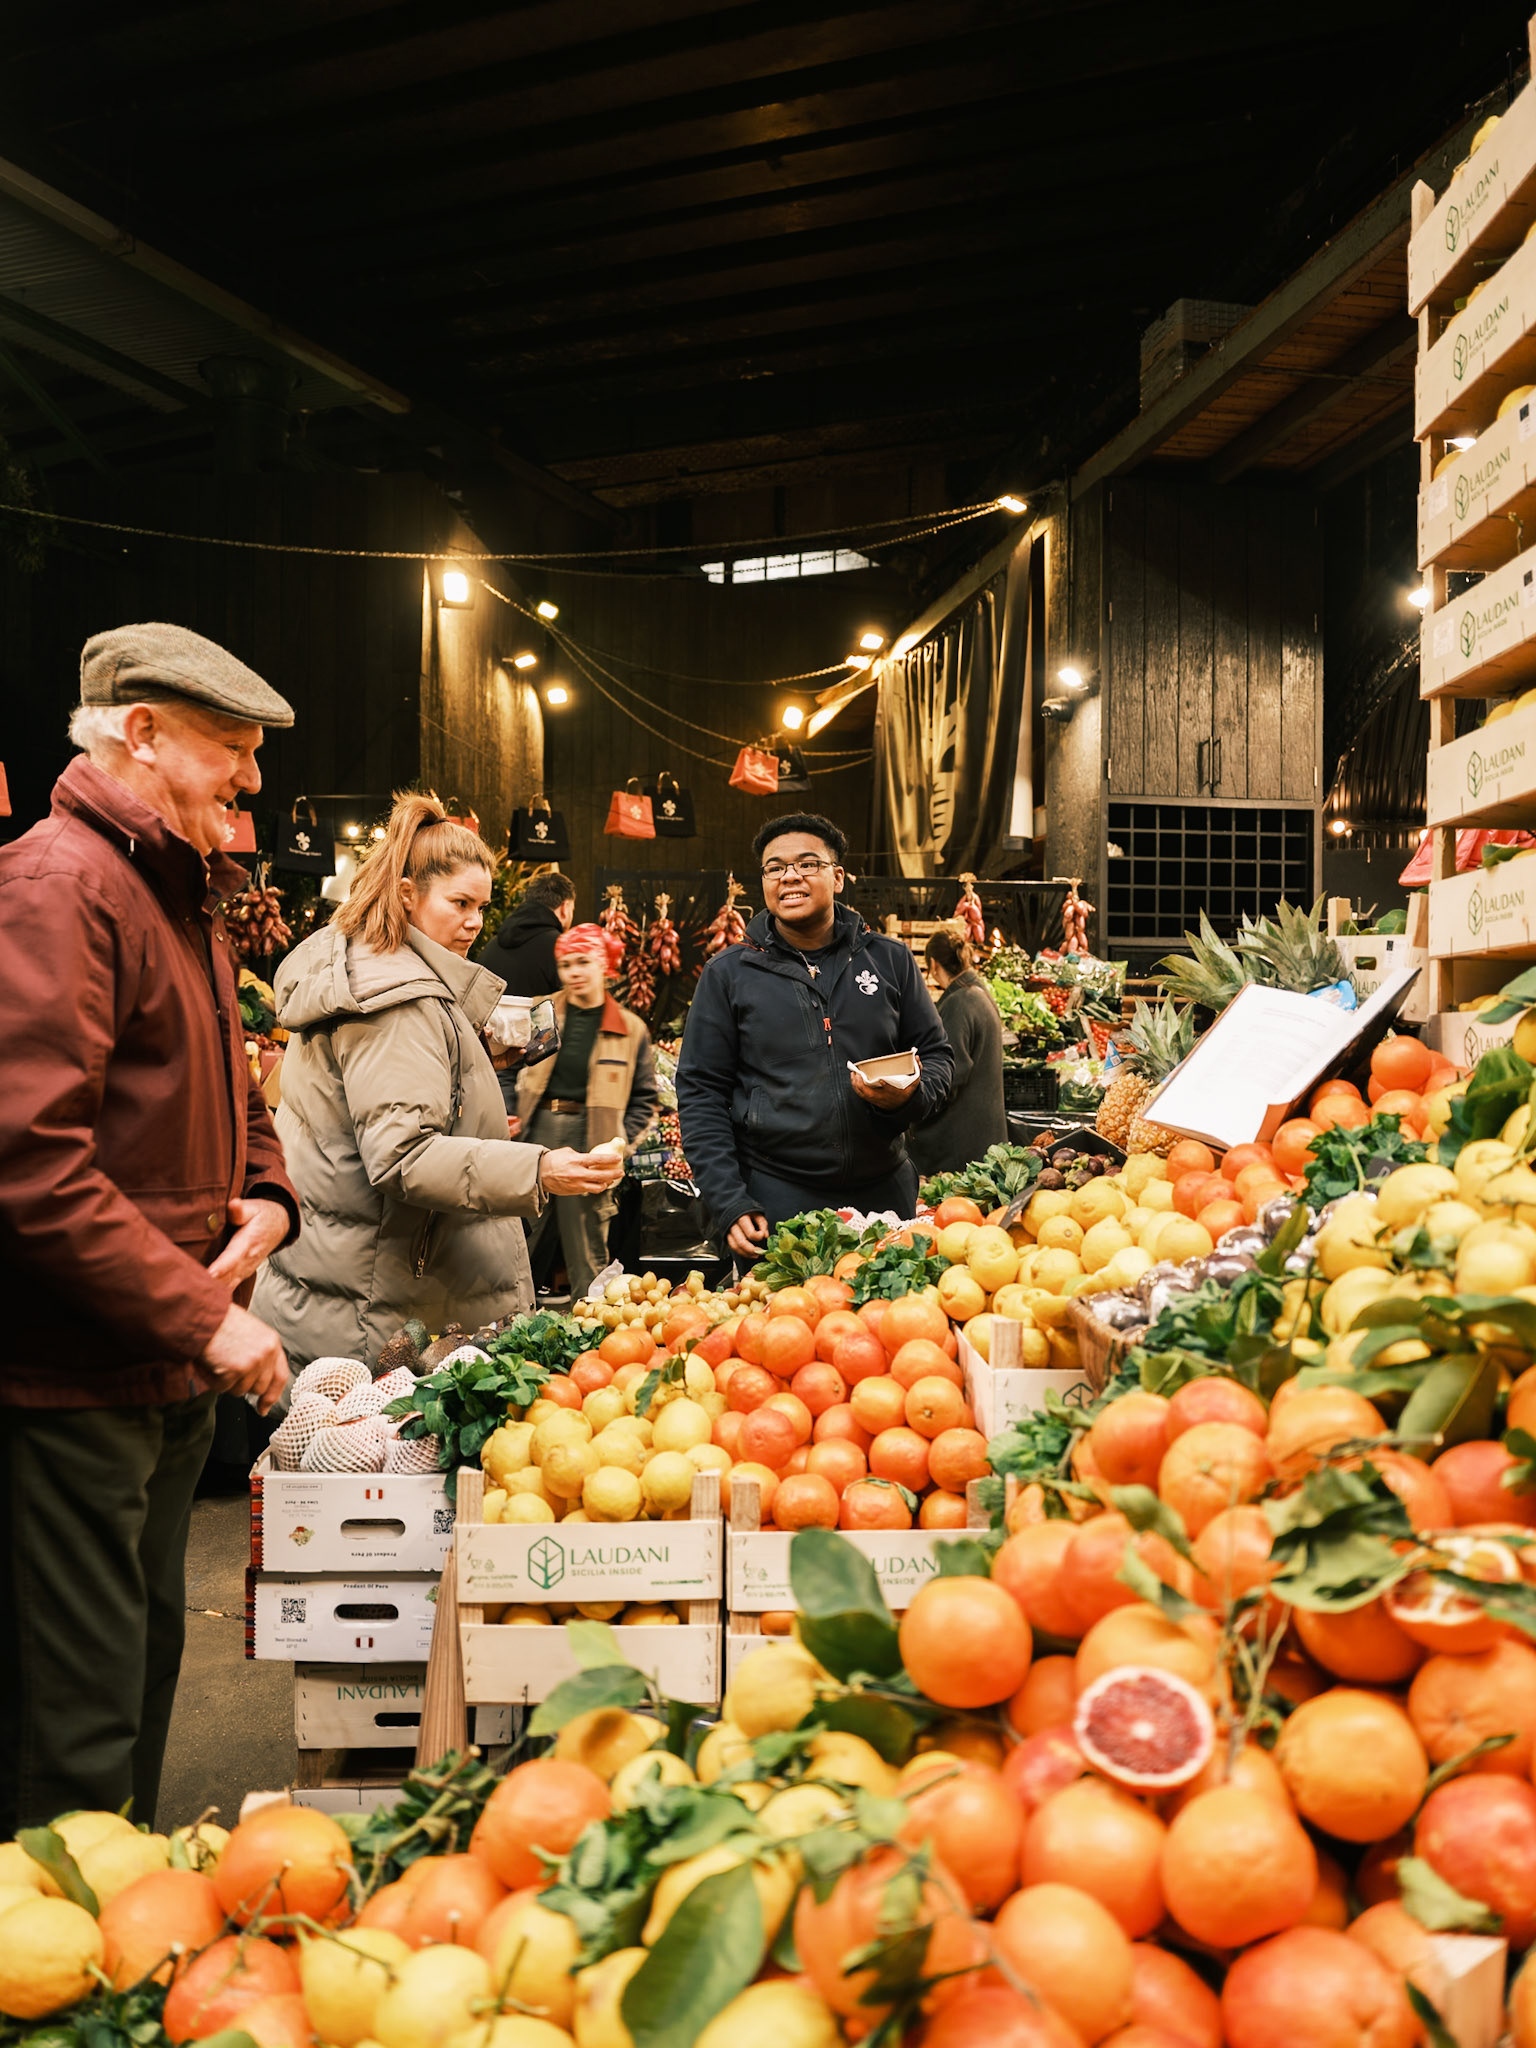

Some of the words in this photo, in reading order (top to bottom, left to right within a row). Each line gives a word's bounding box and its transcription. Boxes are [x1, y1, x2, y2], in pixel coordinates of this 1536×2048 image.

[1460, 158, 1499, 219] LAUDANI
[1468, 295, 1509, 350] LAUDANI
[1469, 445, 1511, 492] LAUDANI
[1476, 590, 1519, 630] LAUDANI
[1483, 741, 1525, 773] LAUDANI
[1484, 889, 1525, 914] LAUDANI
[570, 1546, 669, 1565] LAUDANI
[871, 1556, 938, 1574] UDAN
[570, 1568, 606, 1576] SICILIA
[608, 1567, 643, 1575] INSIDE
[882, 1576, 916, 1585] INSIDE
[337, 1682, 419, 1700] LAUDANI
